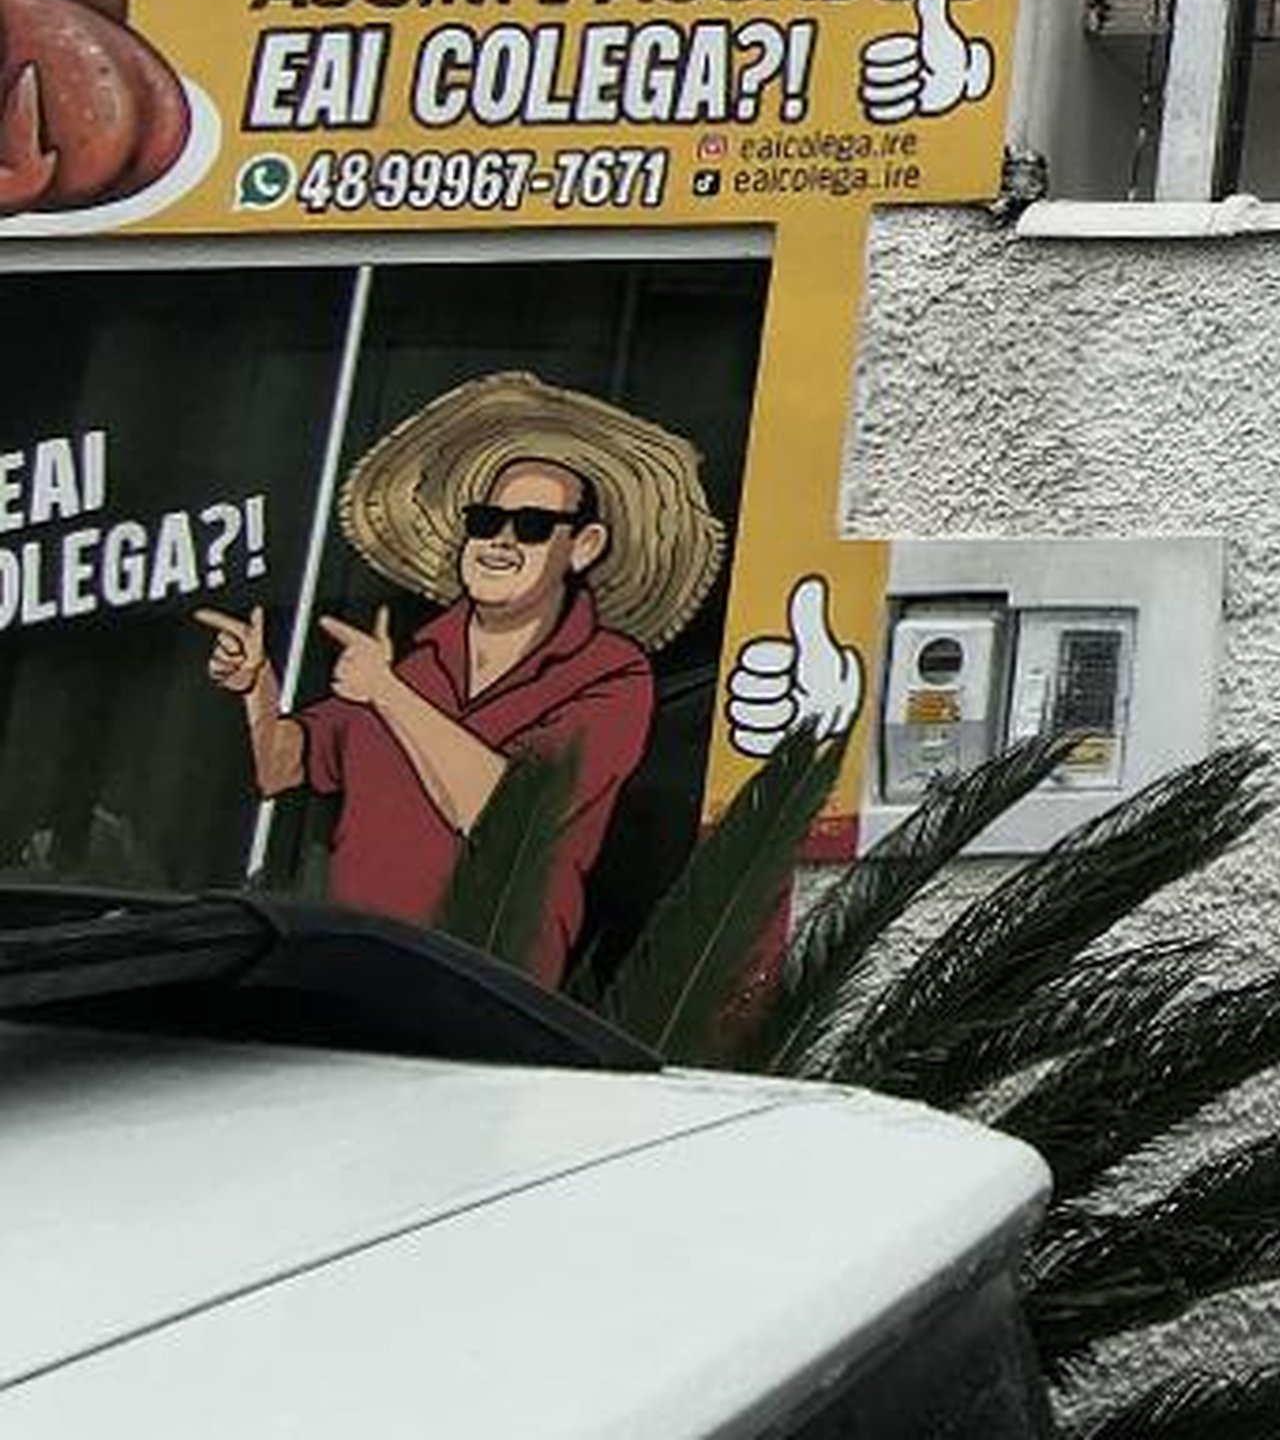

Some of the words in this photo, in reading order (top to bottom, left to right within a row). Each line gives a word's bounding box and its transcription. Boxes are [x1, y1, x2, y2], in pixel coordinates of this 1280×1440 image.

[241, 23, 391, 131] EAI
[410, 17, 818, 128] COLEGA?!
[0, 430, 106, 534] EAI
